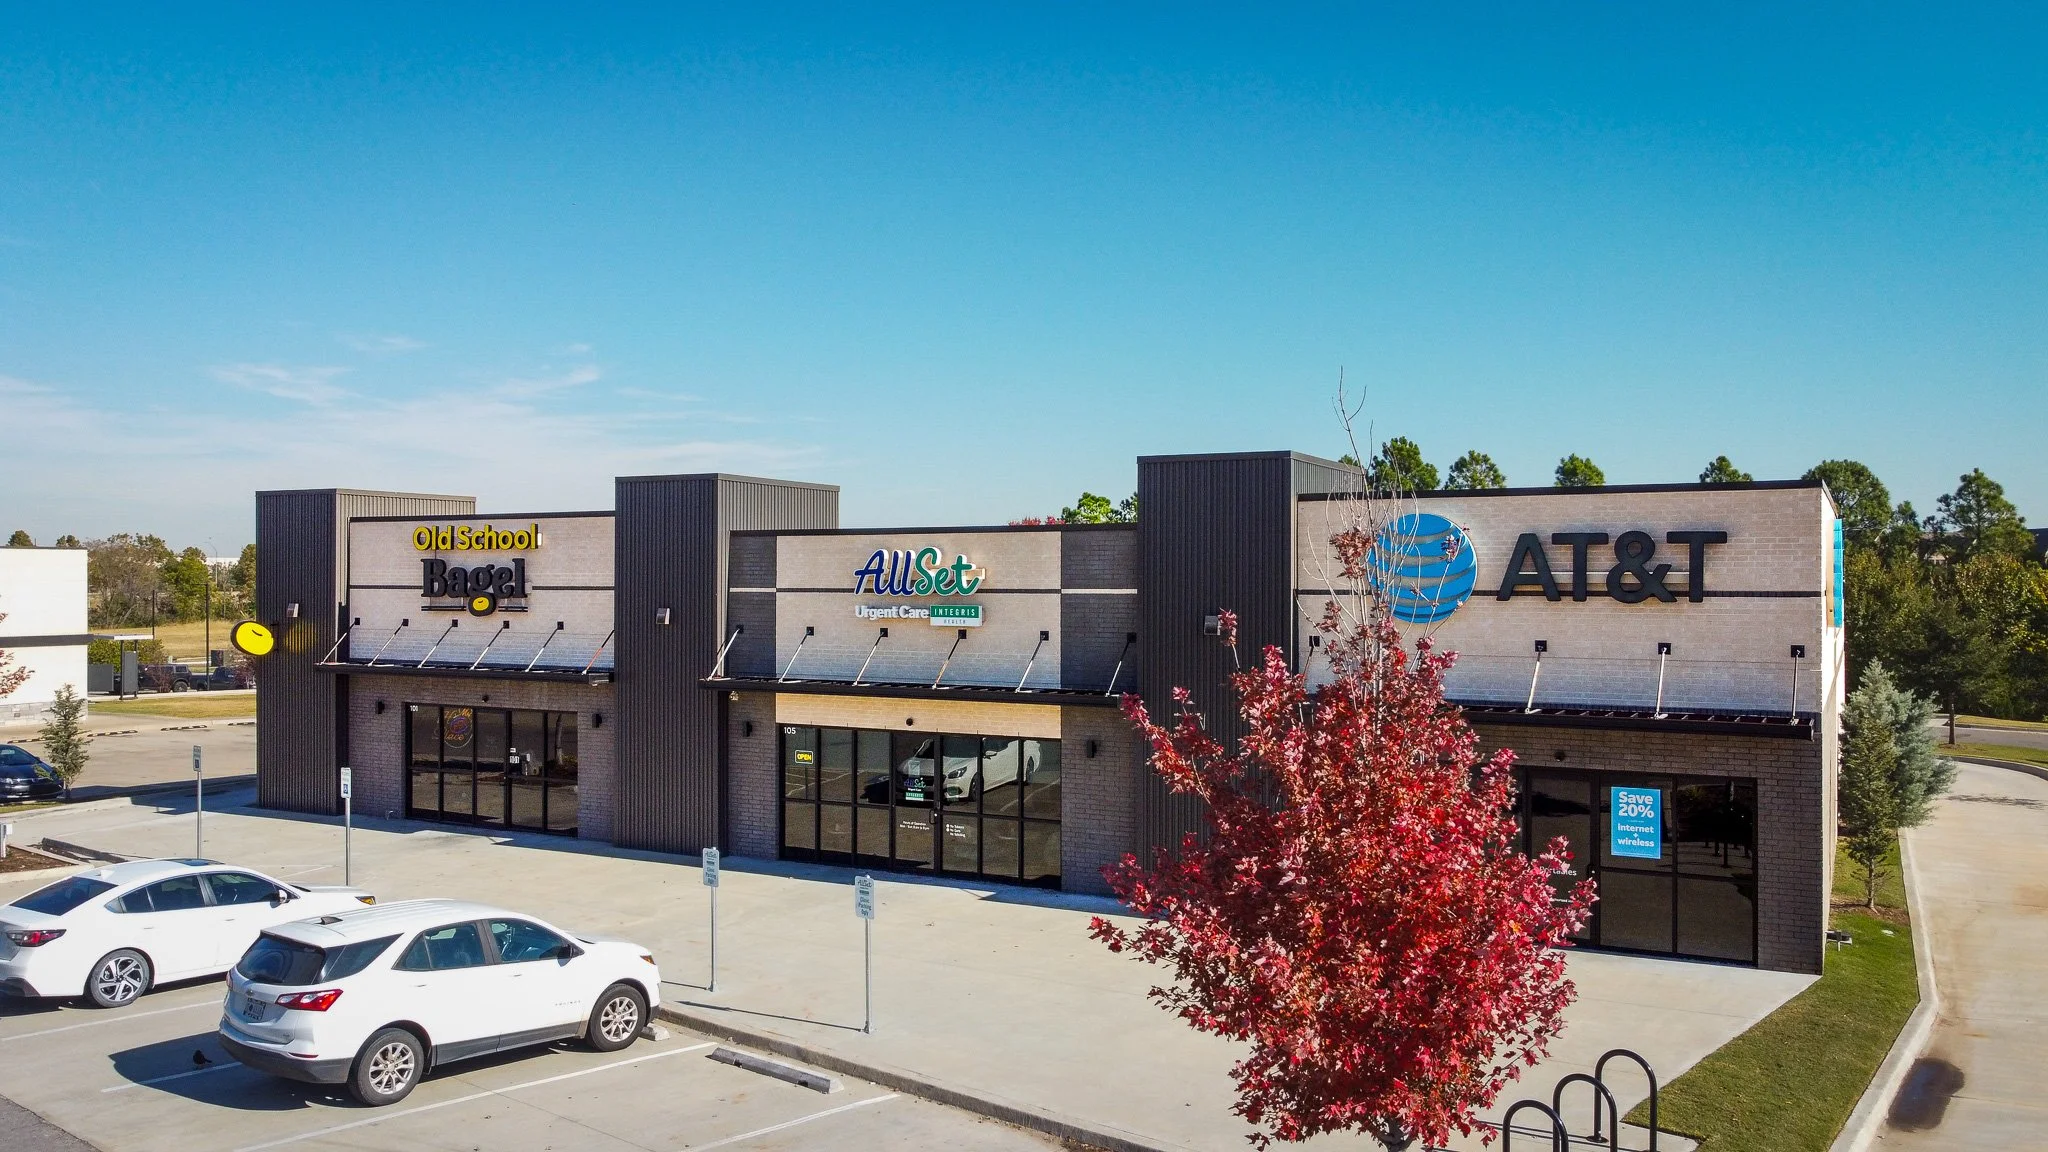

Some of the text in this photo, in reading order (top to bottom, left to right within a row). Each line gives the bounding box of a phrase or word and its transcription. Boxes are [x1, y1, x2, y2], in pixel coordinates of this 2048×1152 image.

[413, 523, 539, 551] Old School
[854, 547, 981, 596] AllSet
[1496, 530, 1728, 603] AT&T
[421, 558, 528, 617] Bagel
[855, 605, 930, 620] Urgent Care
[934, 608, 976, 616] INTEGRIS
[1618, 791, 1654, 804] Save
[1618, 804, 1655, 818] 20%
[1617, 823, 1655, 833] internet
[1617, 837, 1655, 847] wireless
